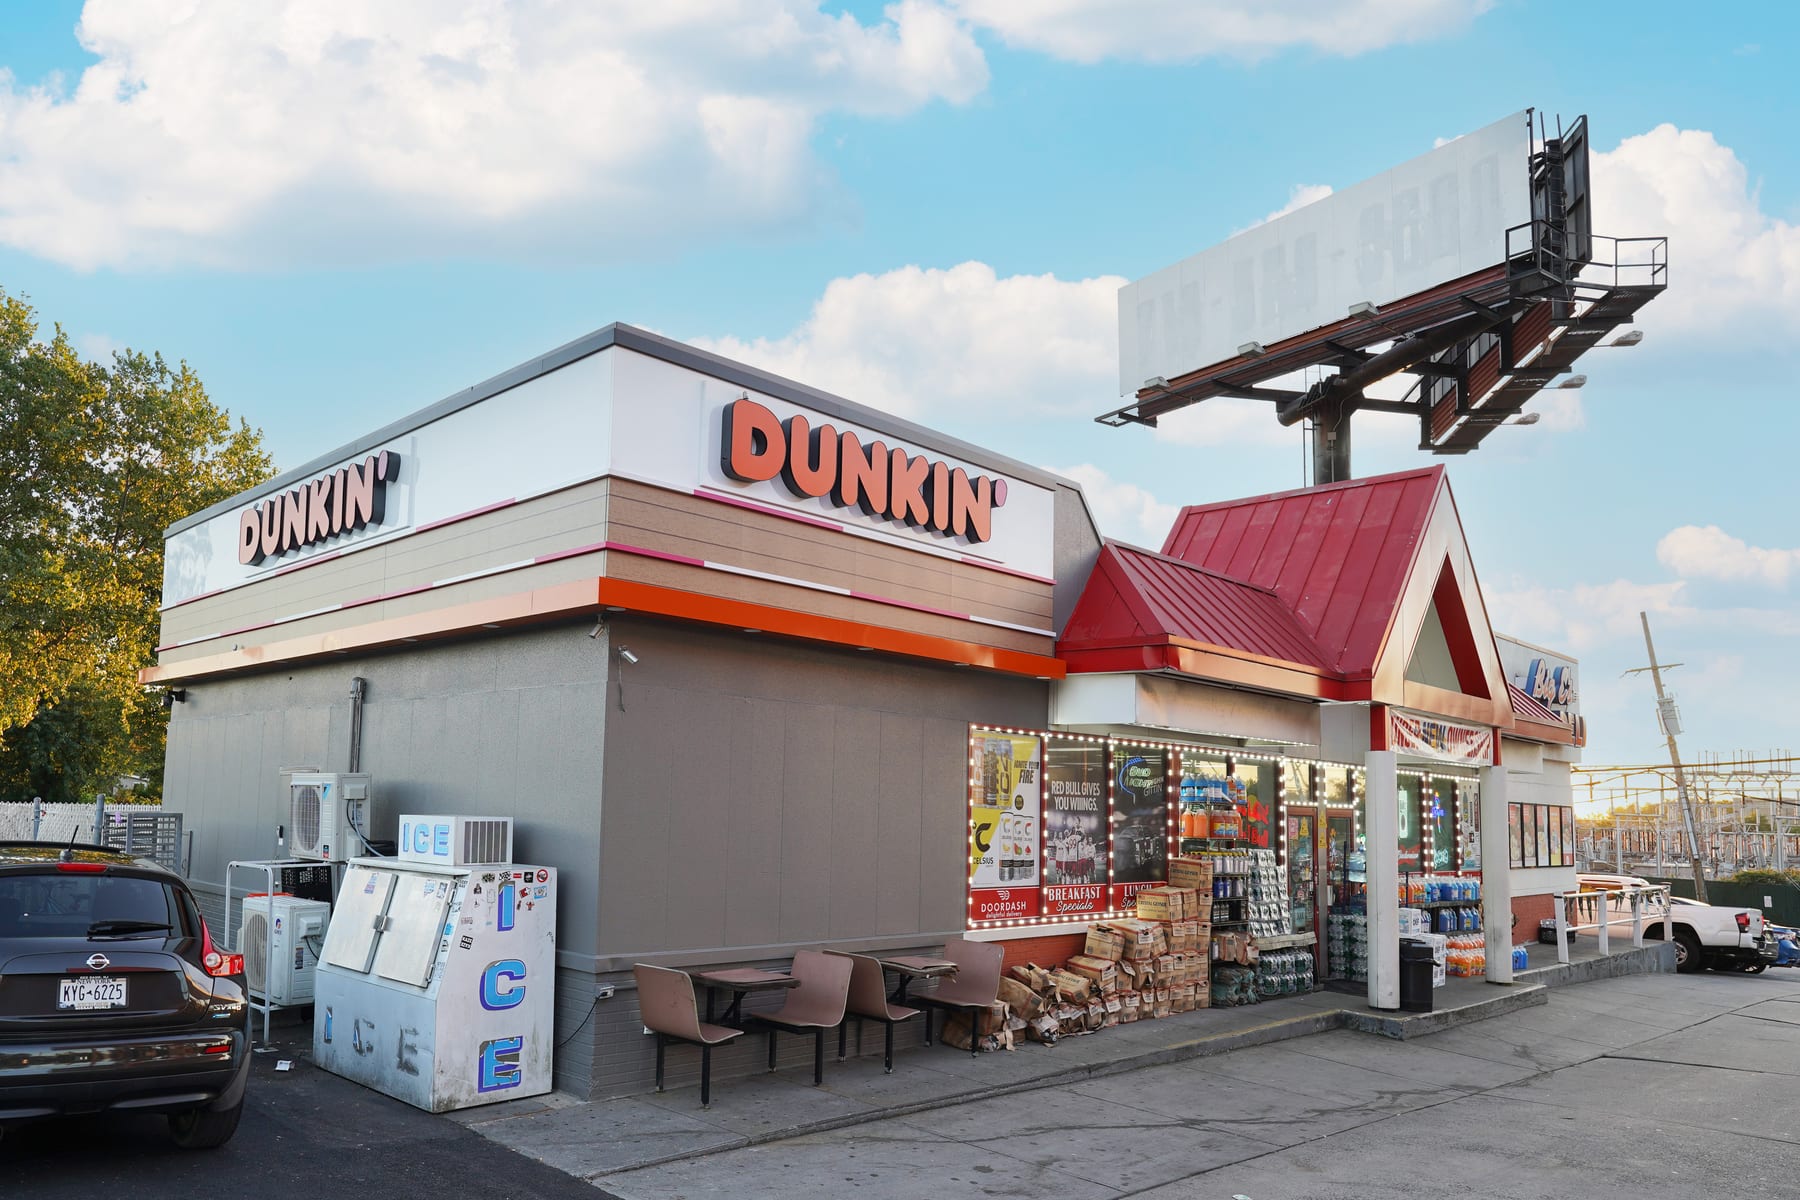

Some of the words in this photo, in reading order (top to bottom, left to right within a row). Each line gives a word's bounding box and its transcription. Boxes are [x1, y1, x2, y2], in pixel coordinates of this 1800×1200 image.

[721, 399, 1008, 544] DUNKIN'
[238, 449, 401, 566] DUNKIN'
[1421, 721, 1447, 750] NEW
[1019, 770, 1034, 784] FIRE
[1052, 780, 1064, 795] RED
[1066, 782, 1081, 796] BULL
[1082, 782, 1100, 796] GIVES
[1054, 796, 1068, 810] YOU
[403, 822, 450, 856] ICE
[1048, 886, 1101, 901] BREAKFAST
[981, 902, 1026, 912] DOORDASH
[1056, 898, 1094, 915] Specials
[64, 984, 85, 1002] KYG
[94, 984, 122, 1000] 6225
[478, 880, 527, 1094] ICE
